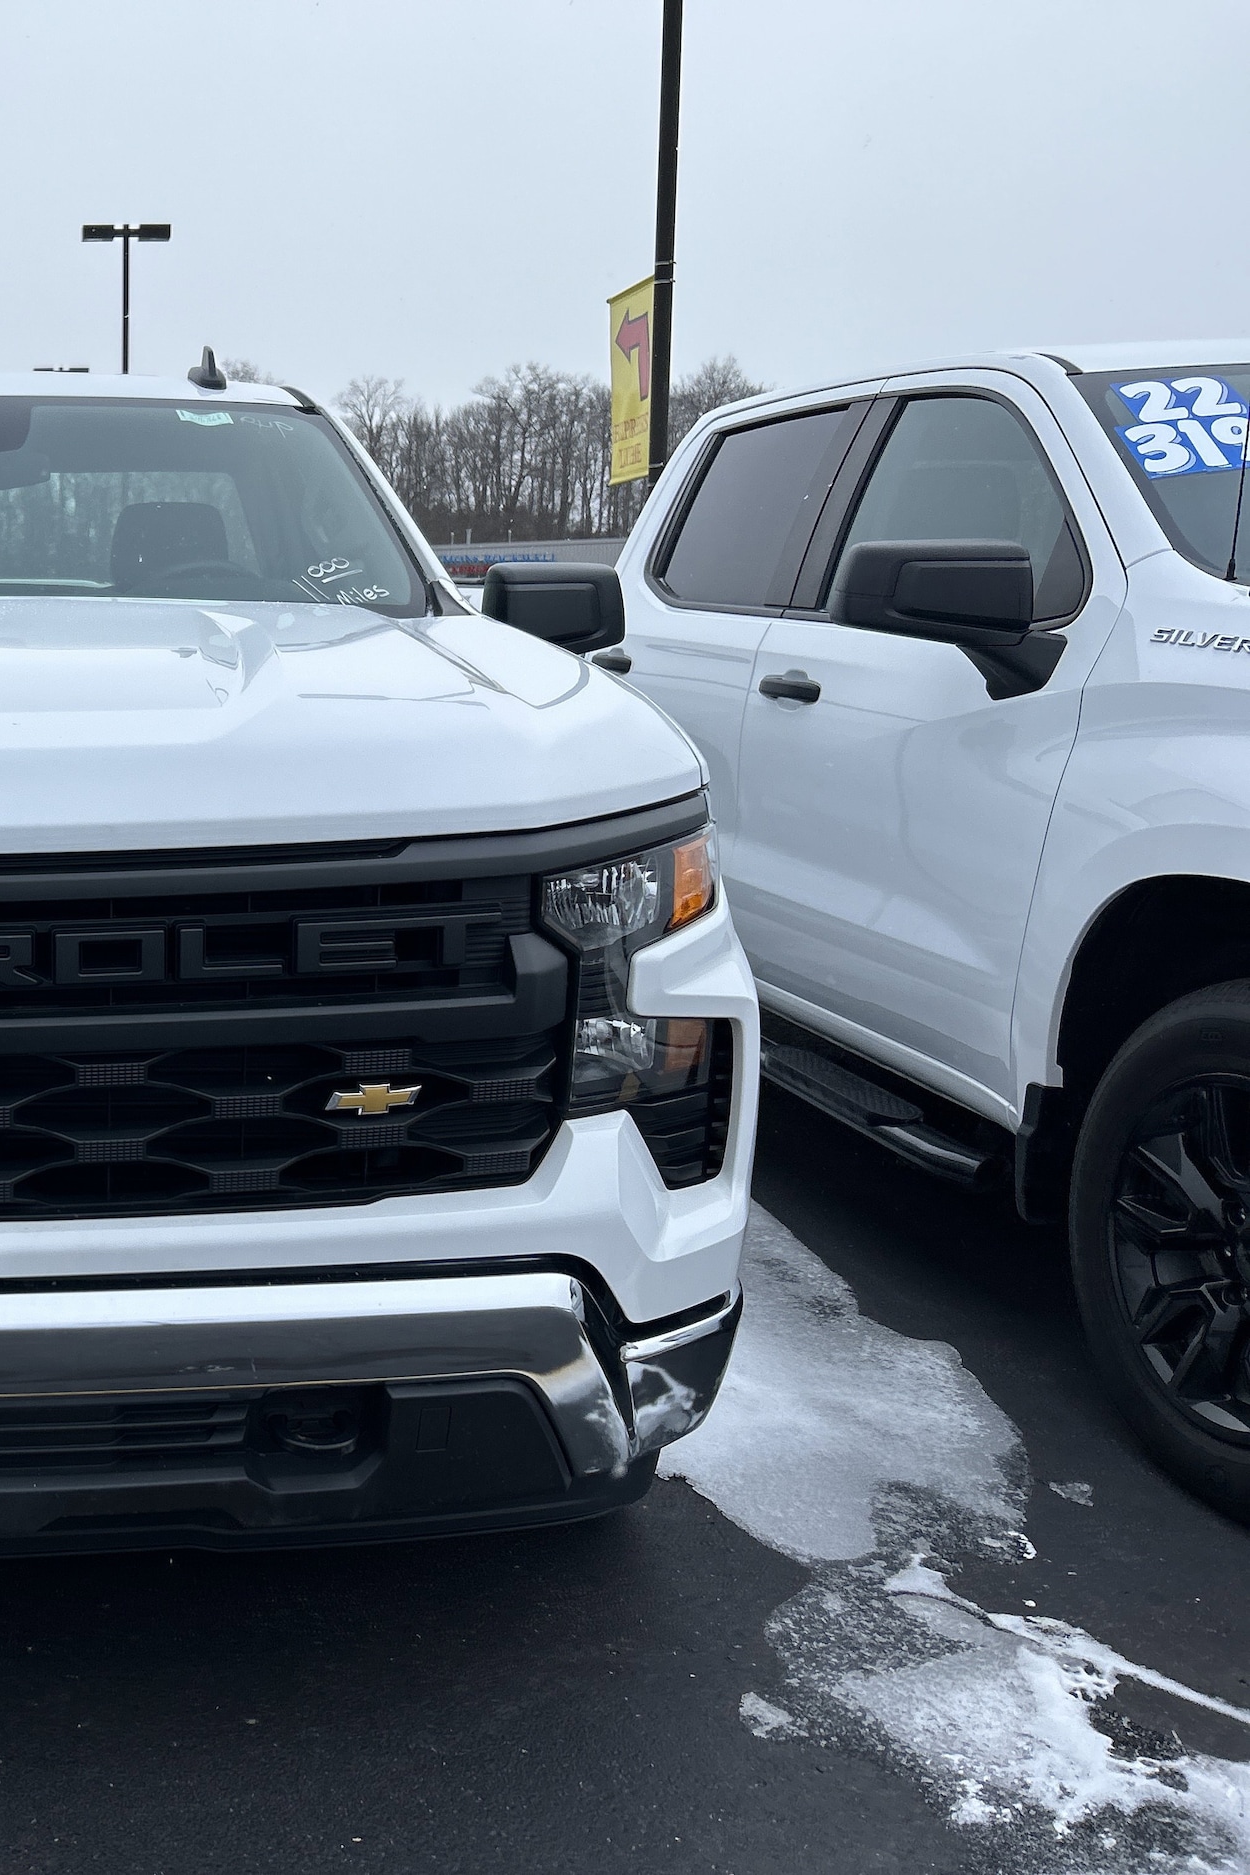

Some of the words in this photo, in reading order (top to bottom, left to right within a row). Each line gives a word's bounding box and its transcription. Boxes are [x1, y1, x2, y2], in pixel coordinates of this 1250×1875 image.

[1120, 377, 1246, 422] 22
[336, 584, 390, 606] Miles
[1150, 626, 1250, 654] SILVER
